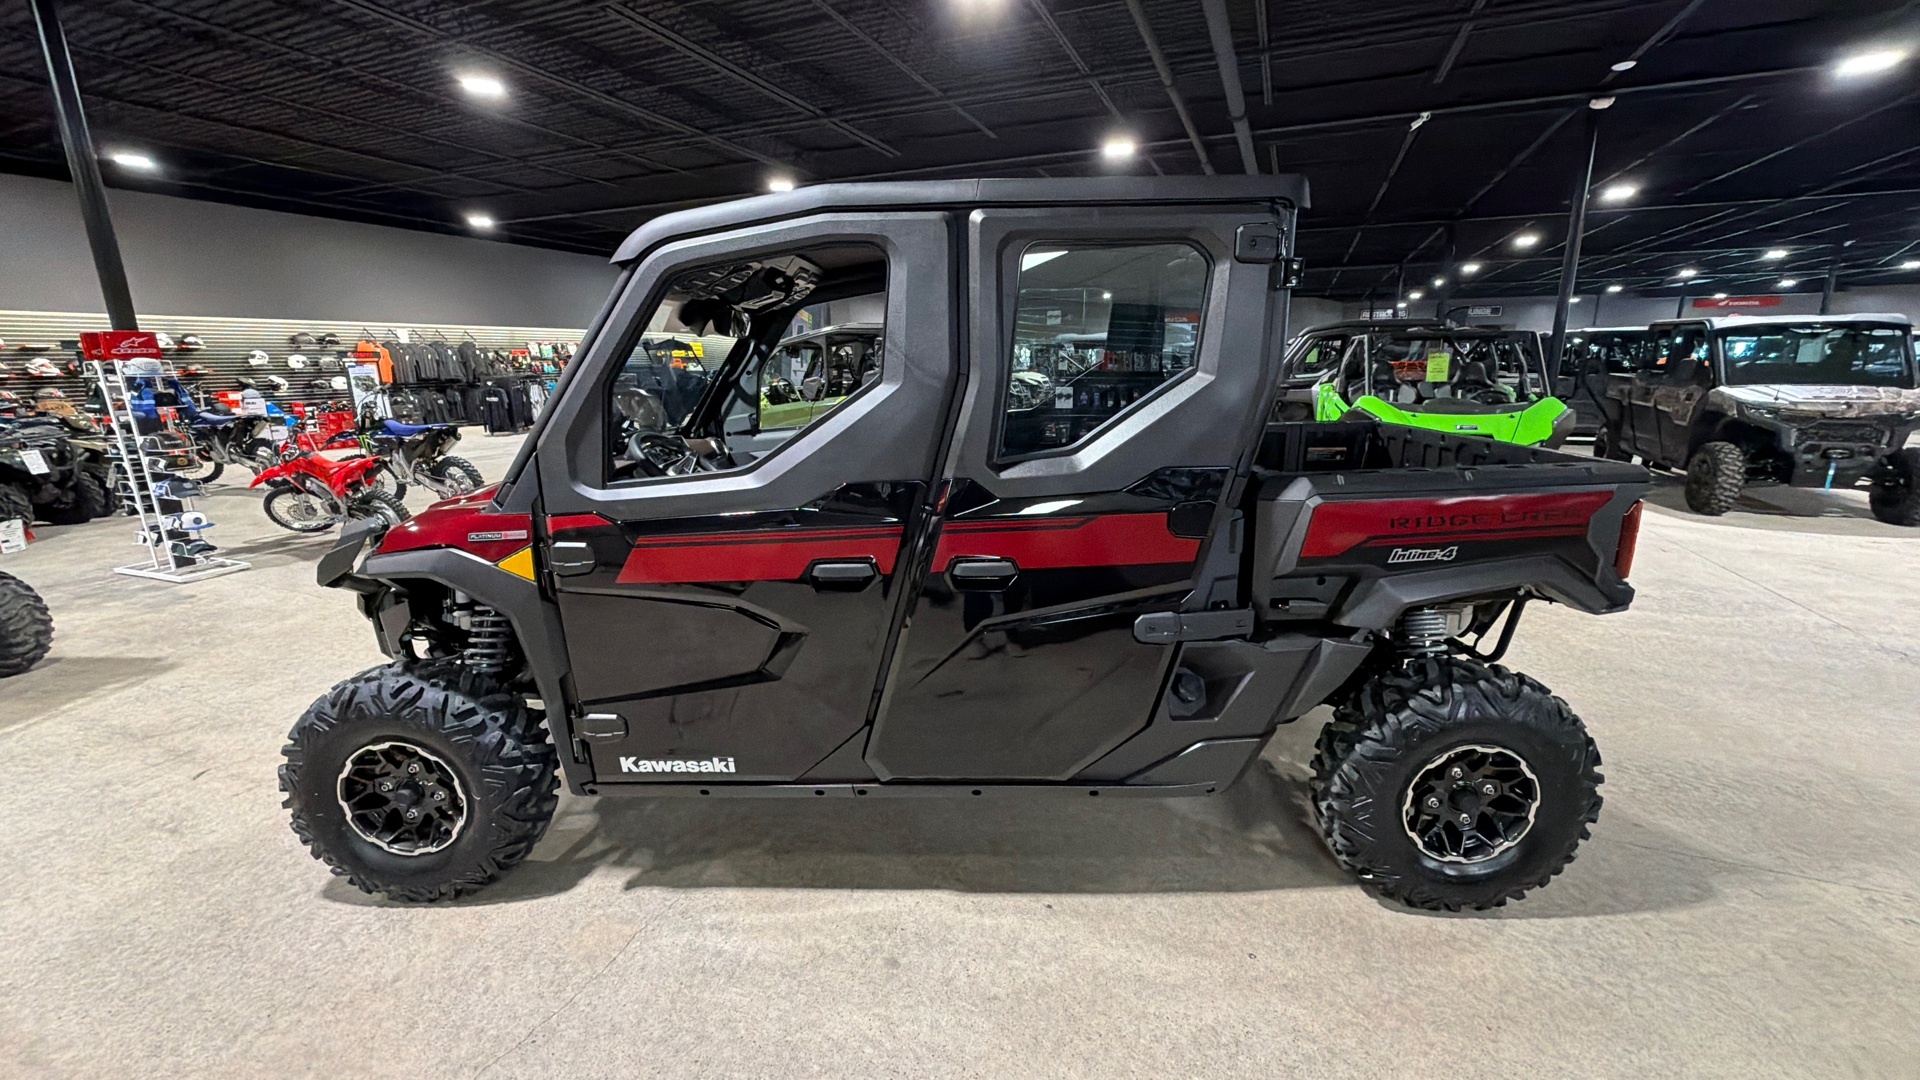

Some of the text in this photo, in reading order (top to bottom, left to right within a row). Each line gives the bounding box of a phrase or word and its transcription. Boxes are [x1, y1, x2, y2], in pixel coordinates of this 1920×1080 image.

[1389, 514, 1488, 528] RIDGE
[1387, 546, 1458, 563] Inline-4
[619, 756, 736, 773] Kawasaki
